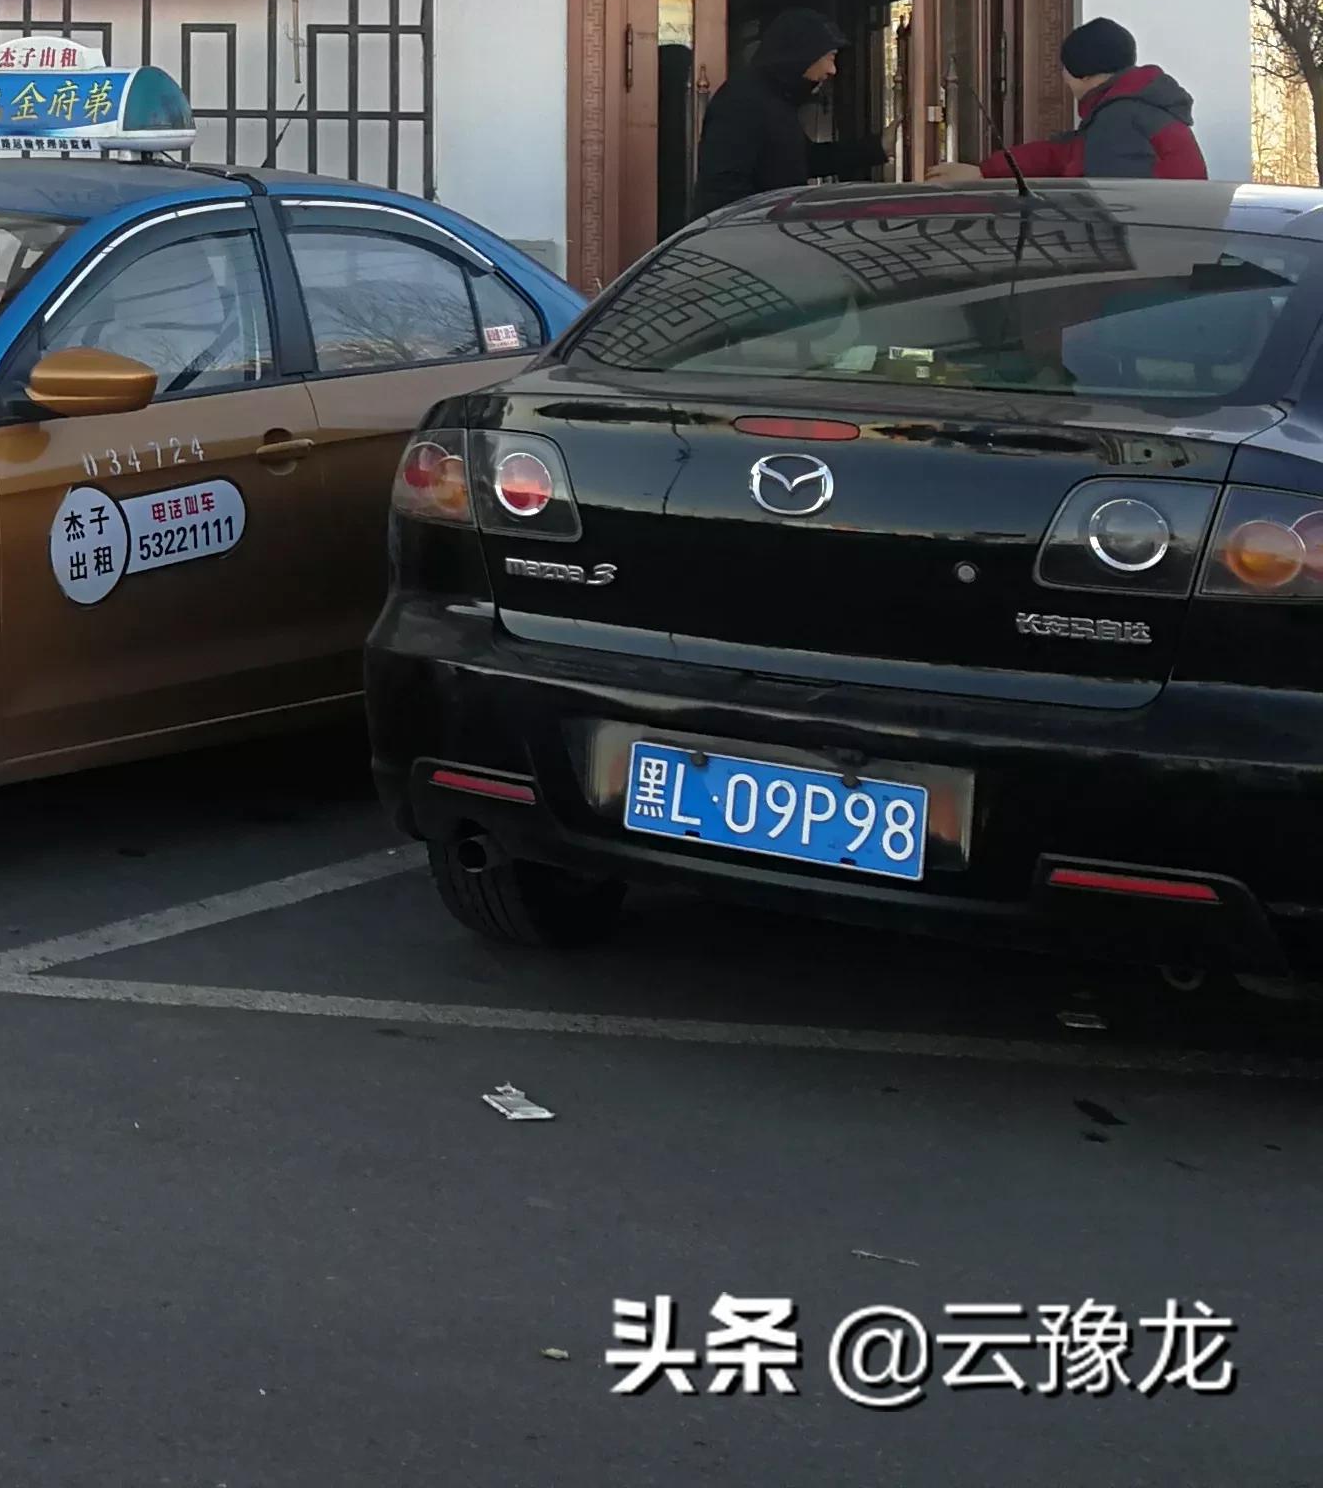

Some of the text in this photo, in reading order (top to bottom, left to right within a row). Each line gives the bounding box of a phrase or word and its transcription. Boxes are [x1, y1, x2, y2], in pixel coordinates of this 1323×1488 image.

[63, 505, 110, 542] 杰子
[151, 492, 215, 524] 电话叫车
[138, 515, 235, 561] 53221111
[69, 545, 115, 582] 出租
